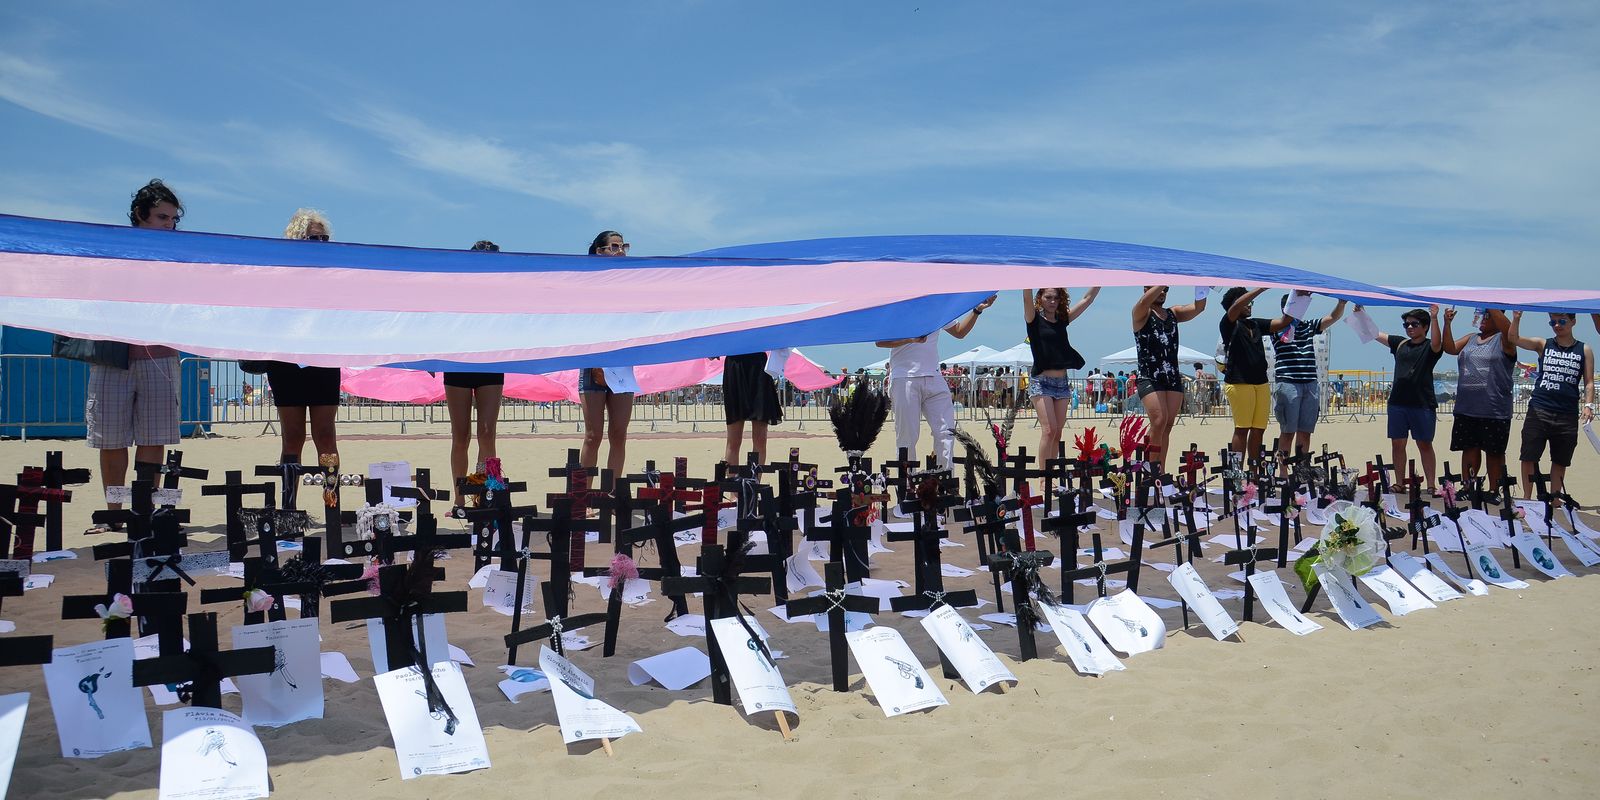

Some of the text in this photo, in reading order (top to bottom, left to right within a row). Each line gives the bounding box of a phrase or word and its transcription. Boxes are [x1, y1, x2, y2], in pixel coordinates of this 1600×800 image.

[1545, 348, 1581, 361] Ubatuba
[1543, 356, 1580, 369] Maresias
[1543, 371, 1577, 384] Praia da
[1539, 379, 1560, 390] Pipa
